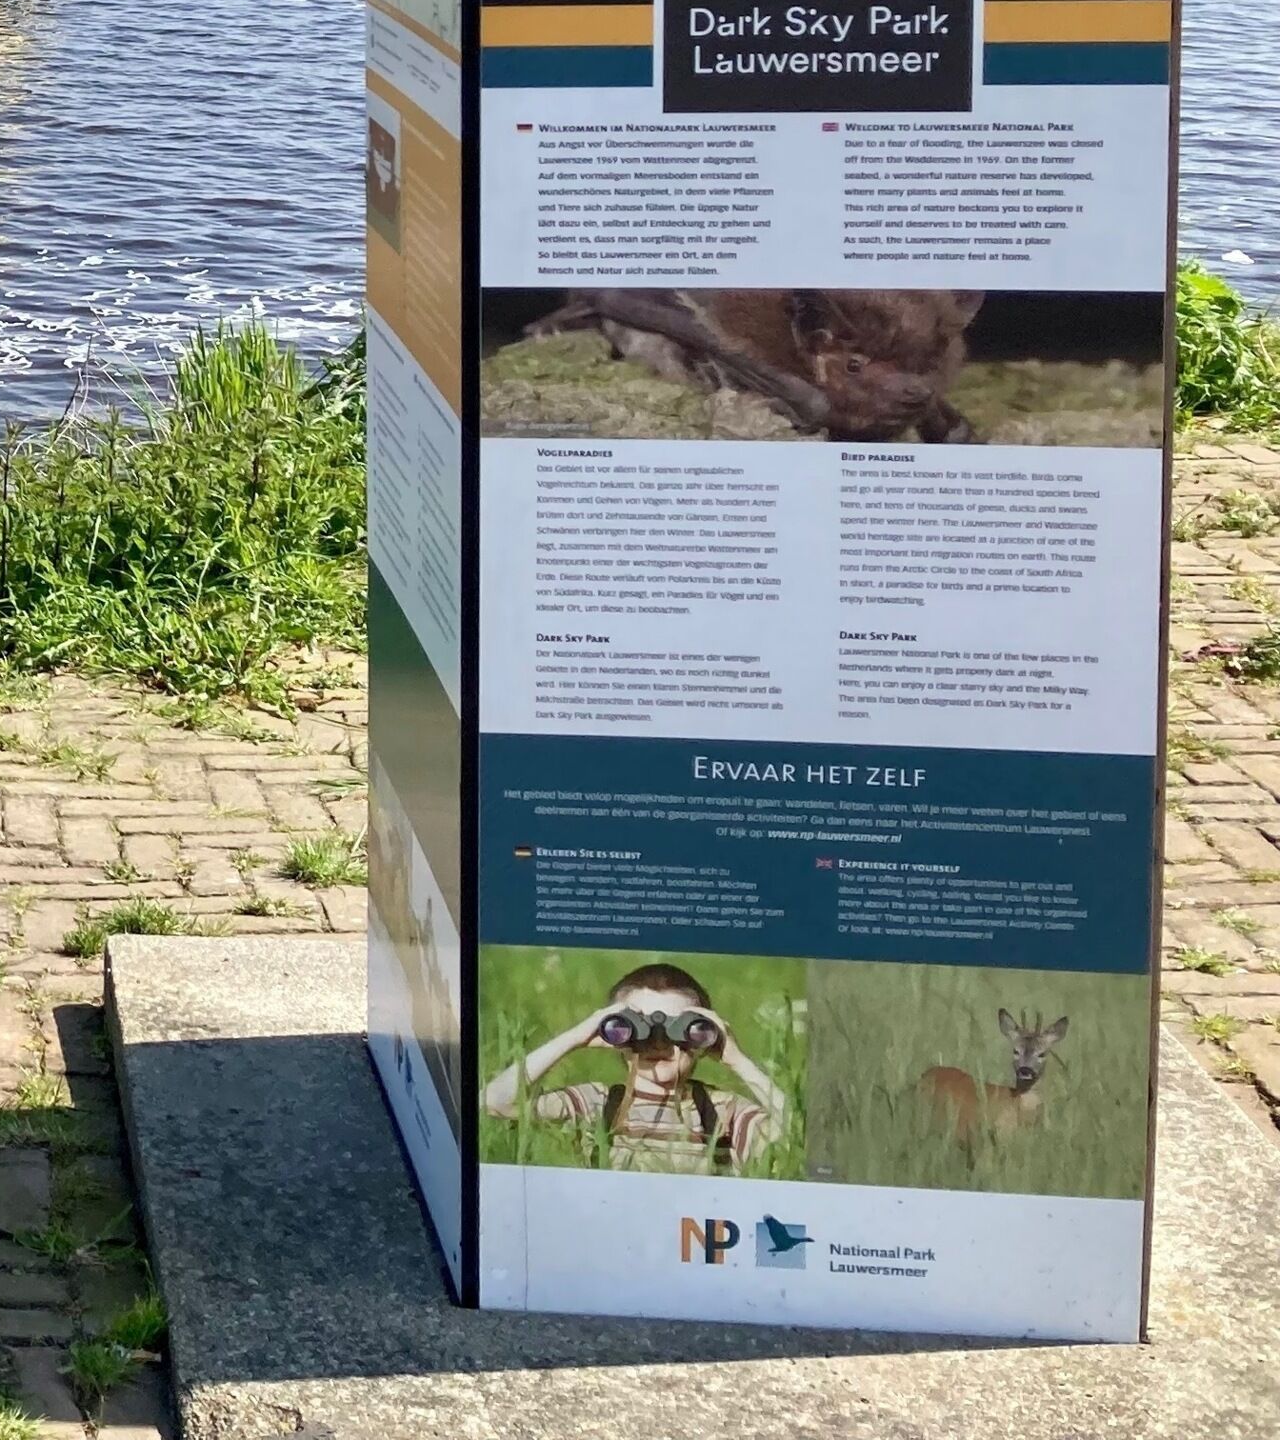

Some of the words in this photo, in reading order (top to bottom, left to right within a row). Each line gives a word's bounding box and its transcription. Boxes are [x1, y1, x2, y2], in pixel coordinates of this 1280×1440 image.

[690, 7, 772, 37] Dark
[784, 6, 854, 42] Sky
[870, 5, 949, 35] Park
[694, 45, 940, 74] Lauwersmeer
[844, 139, 864, 148] Due
[866, 139, 877, 148] to
[878, 140, 886, 148] a
[887, 139, 908, 148] fear
[909, 139, 920, 148] of
[967, 139, 984, 148] the
[986, 140, 1046, 148] Lauwerszee
[1047, 140, 1069, 148] was
[1070, 139, 1104, 148] closed
[844, 155, 859, 164] off
[860, 155, 884, 164] from
[886, 155, 903, 164] the
[904, 155, 962, 164] Waddenzee
[963, 156, 974, 164] in
[1004, 155, 1019, 164] On
[1021, 156, 1039, 164] the
[1041, 155, 1075, 164] former
[883, 172, 891, 180] a
[892, 171, 943, 180] wonderful
[944, 172, 978, 180] nature
[1019, 172, 1038, 180] has
[844, 188, 875, 196] where
[877, 188, 906, 198] many
[906, 188, 938, 197] plants
[939, 188, 959, 197] and
[959, 188, 1000, 197] animals
[1001, 188, 1020, 197] feel
[1022, 188, 1033, 197] at
[829, 1243, 901, 1259] Nationaal
[903, 1247, 936, 1261] Park
[829, 1260, 928, 1278] Lauwersmeer
